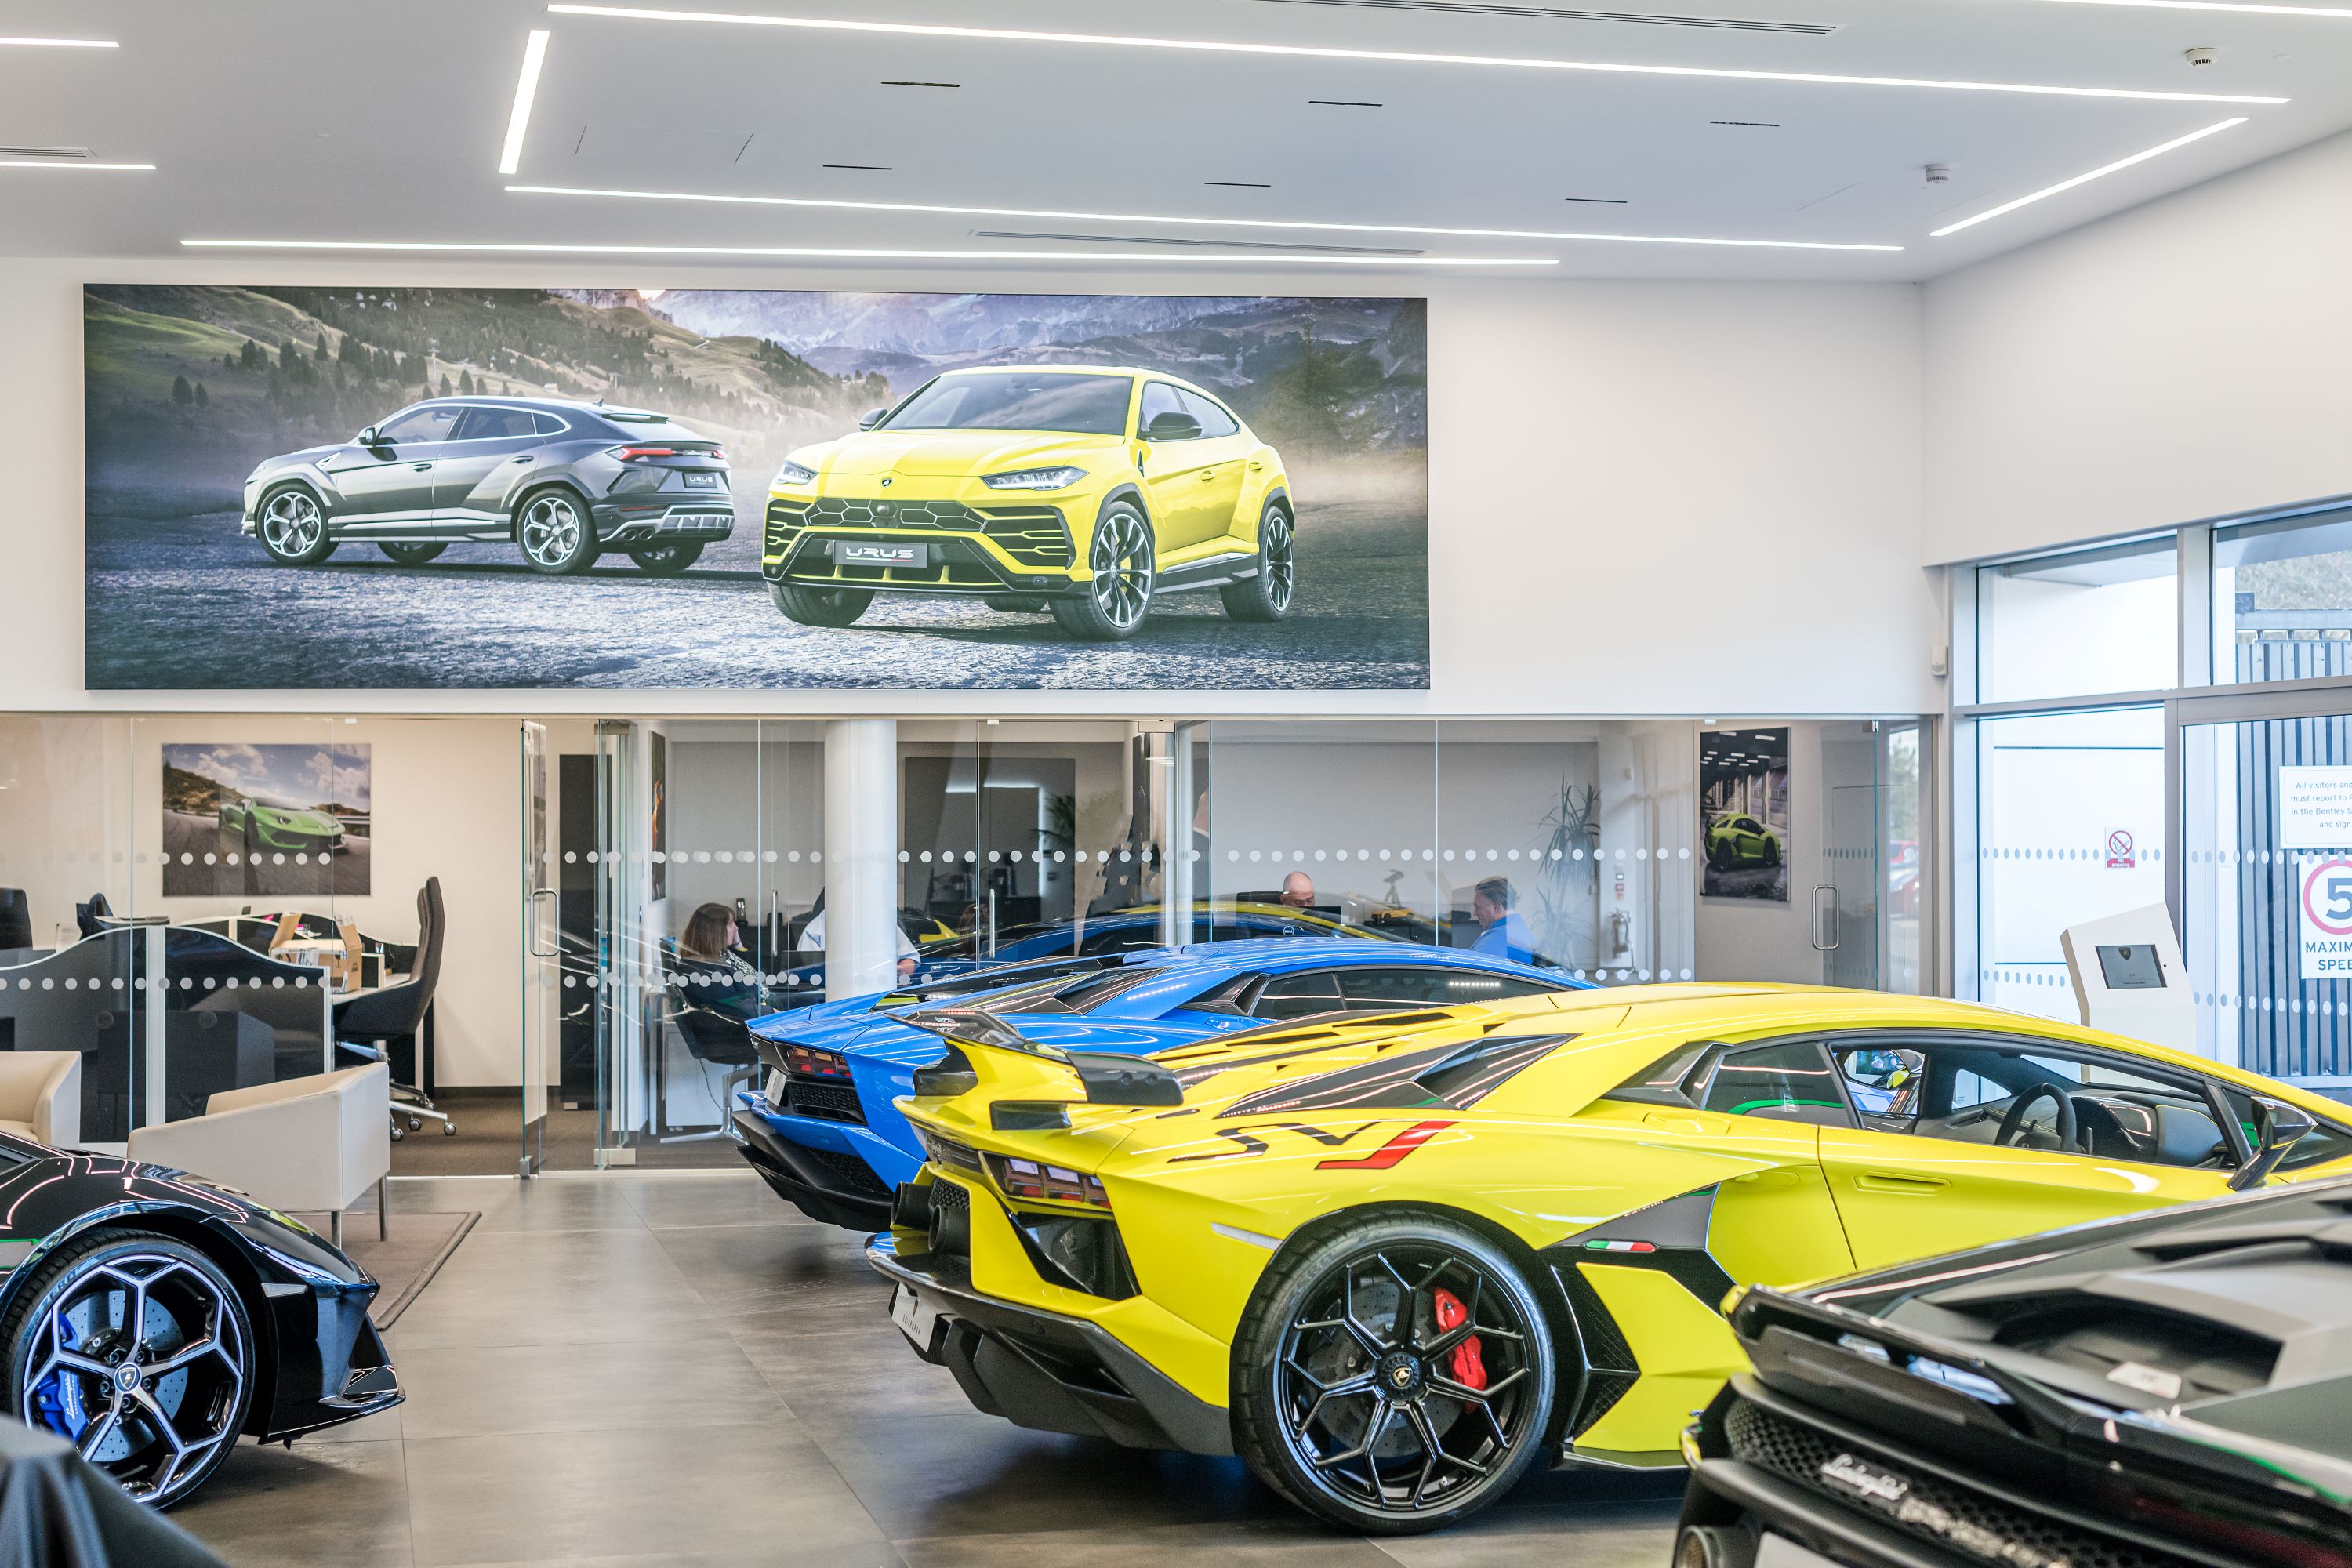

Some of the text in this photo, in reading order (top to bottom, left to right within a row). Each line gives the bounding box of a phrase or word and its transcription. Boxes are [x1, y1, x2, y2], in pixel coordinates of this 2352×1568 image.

[846, 546, 914, 559] URUS
[2312, 794, 2336, 803] report
[2316, 808, 2345, 816] Bentley
[2326, 877, 2352, 920] 5
[1166, 1119, 1459, 1170] SVJ
